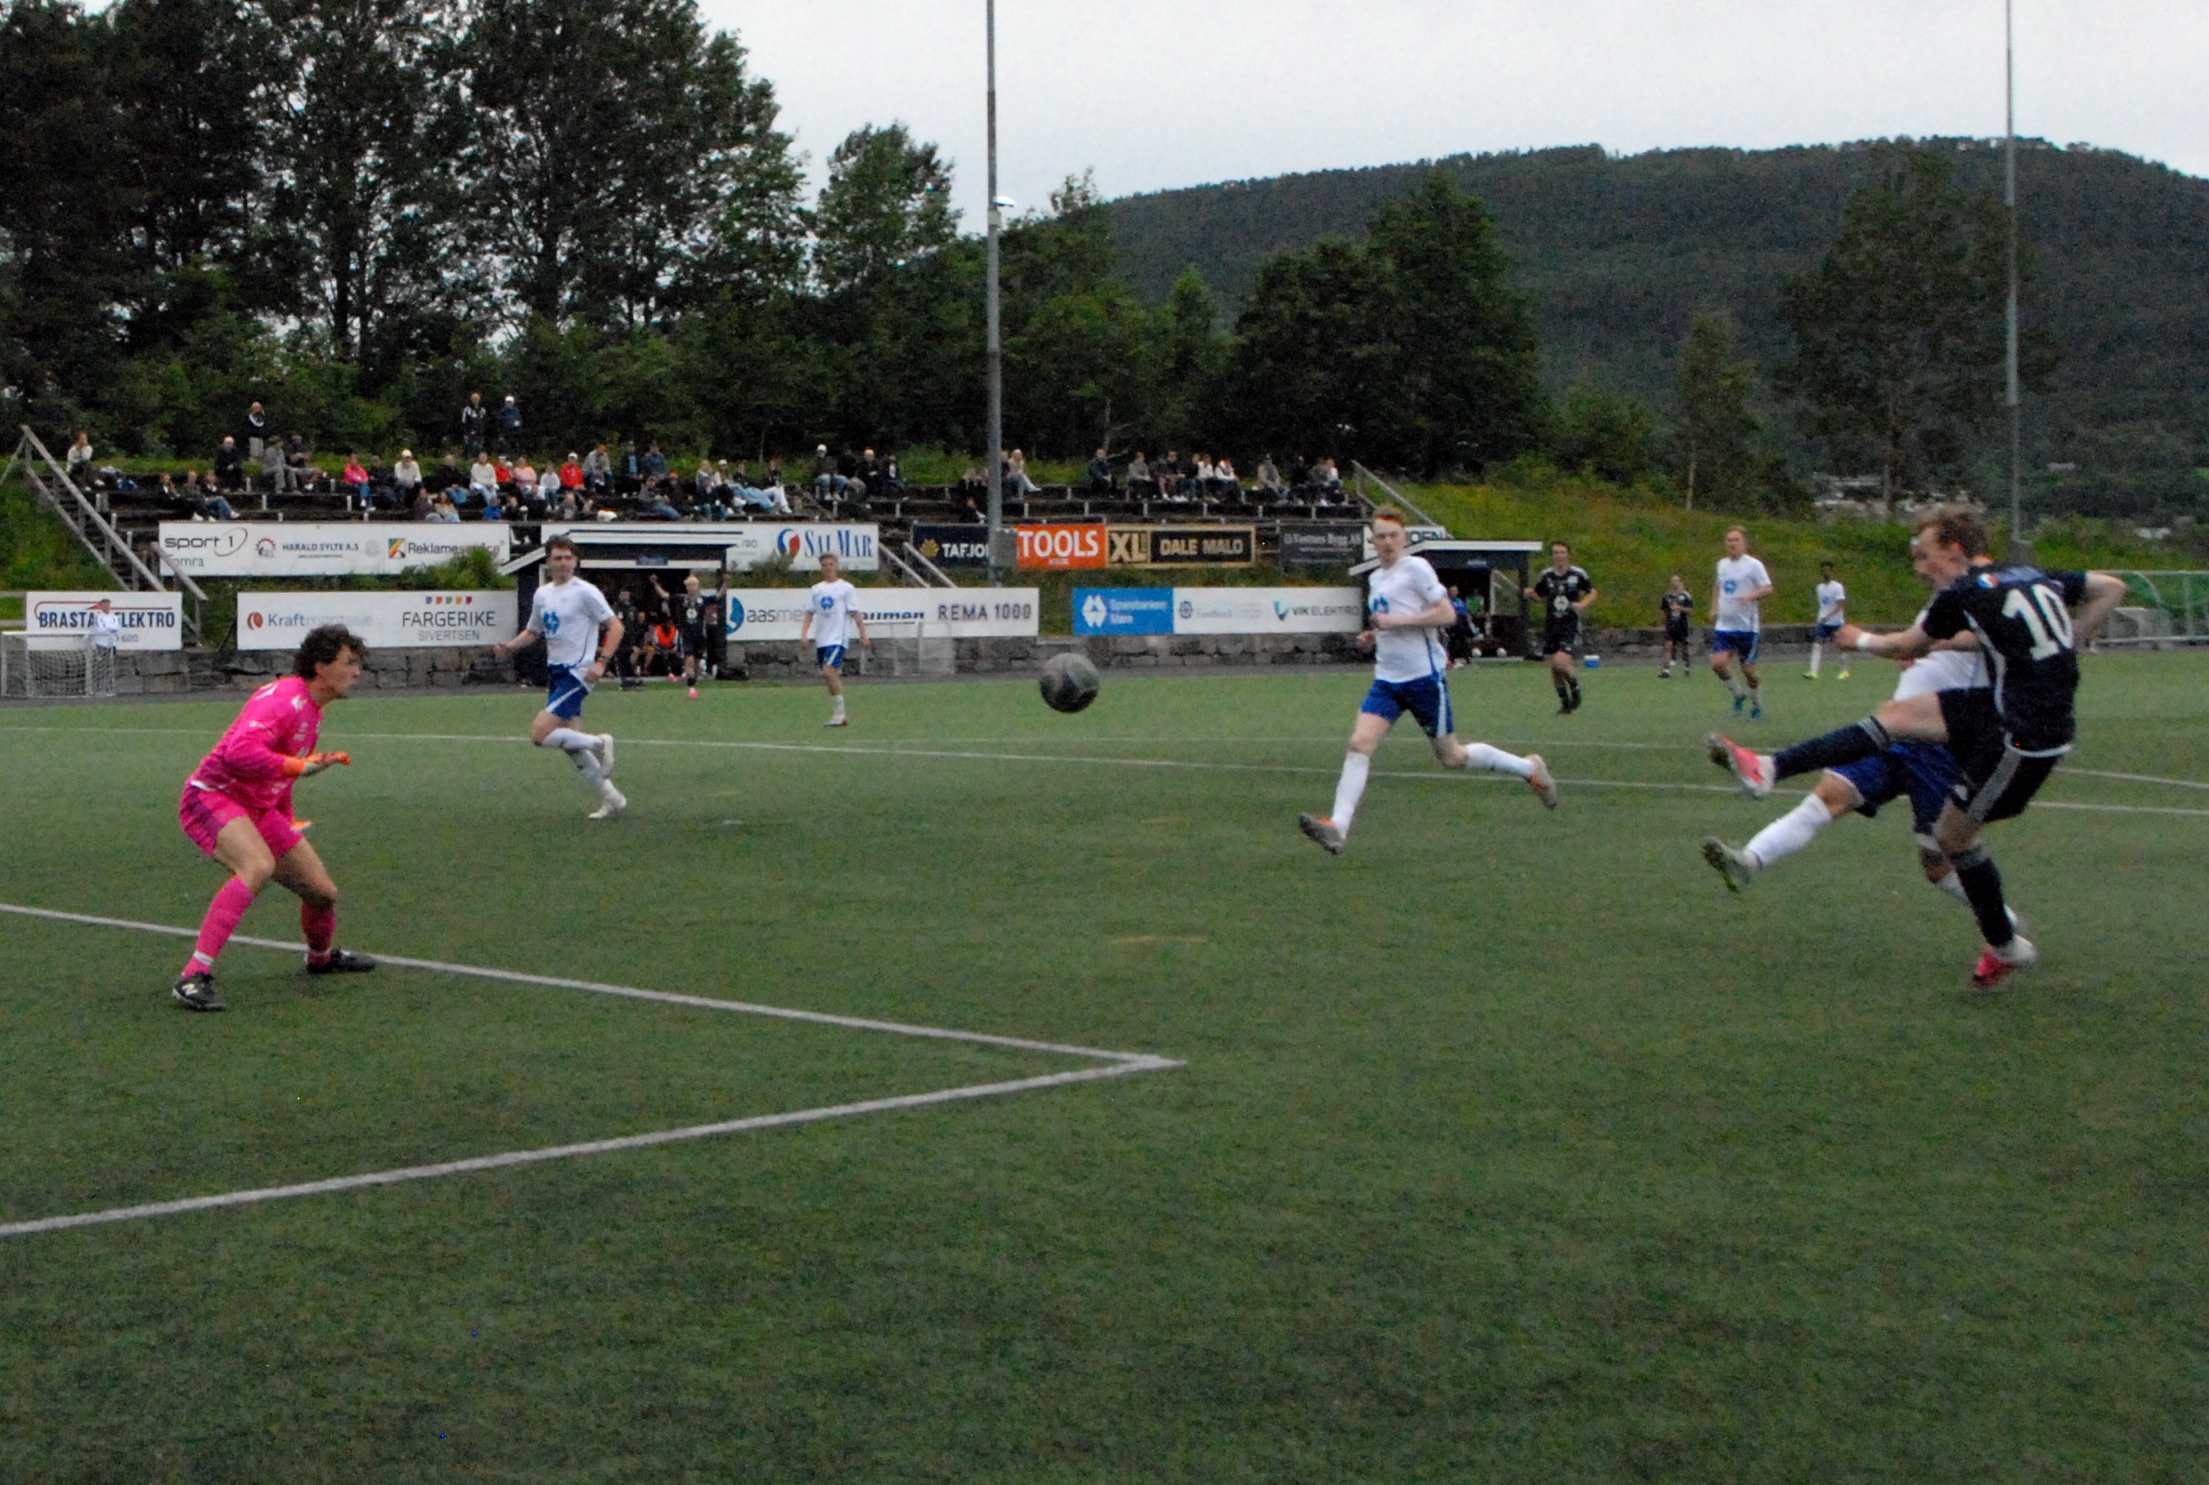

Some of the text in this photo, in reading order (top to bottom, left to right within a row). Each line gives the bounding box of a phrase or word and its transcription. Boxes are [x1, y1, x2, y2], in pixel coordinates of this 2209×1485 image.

[165, 536, 219, 549] sport
[942, 543, 990, 558] TAFJO
[1018, 530, 1099, 558] TOOLS
[1159, 538, 1198, 556] DALE
[39, 611, 98, 628] BRASTA
[402, 611, 497, 627] FARGERIKE
[746, 609, 801, 623] aasme
[938, 603, 1032, 621] REMA 1000
[2003, 583, 2074, 661] 10
[418, 629, 480, 641] SIVERTSEN
